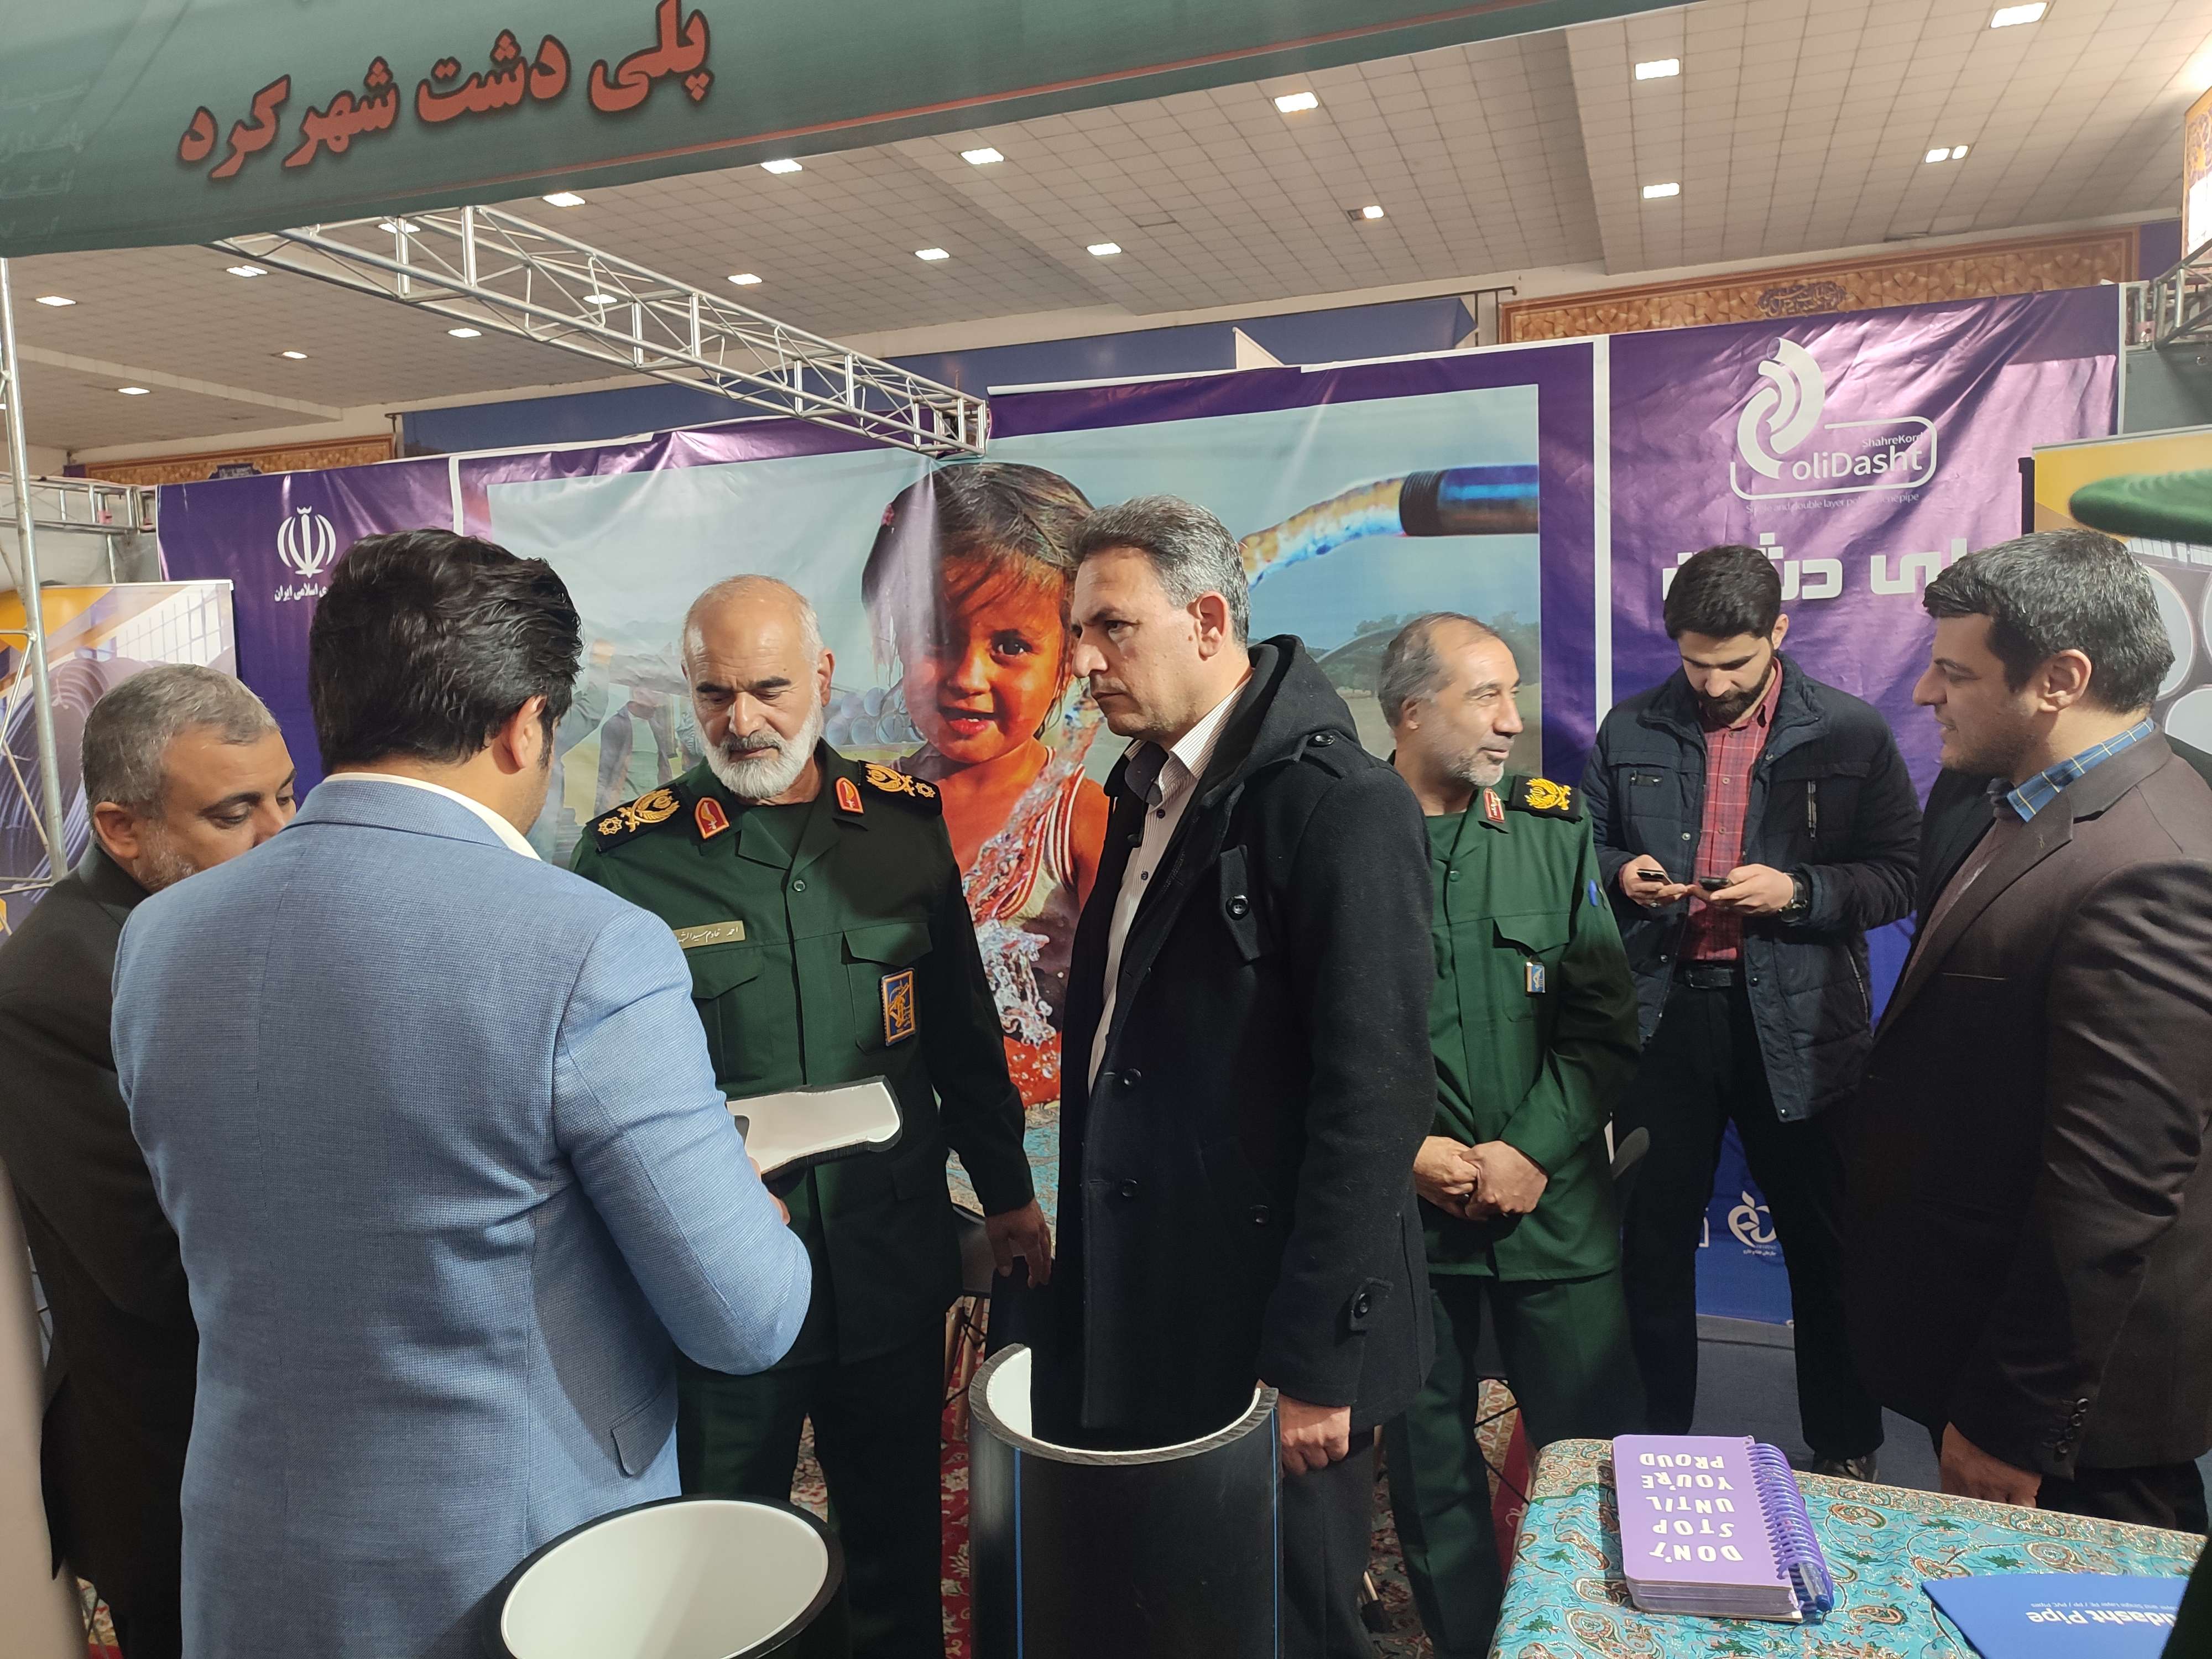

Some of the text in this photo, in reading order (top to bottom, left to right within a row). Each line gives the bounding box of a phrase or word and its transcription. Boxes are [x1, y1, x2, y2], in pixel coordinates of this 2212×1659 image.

[587, 0, 714, 112] پلی
[415, 29, 571, 123] دشت
[1773, 501, 1790, 512] and
[1791, 500, 1822, 511] double
[1824, 498, 1843, 509] layer
[1899, 492, 1919, 504] pipe
[274, 584, 293, 602] ایران
[294, 582, 318, 601] اسلامی
[1639, 1453, 1724, 1469] PROUD
[1641, 1472, 1734, 1490] YOU'RE
[1646, 1496, 1735, 1514] UNTIL
[1652, 1519, 1735, 1538] STOP
[1648, 1542, 1744, 1563] DON'T
[2025, 1608, 2089, 1625] Pipe
